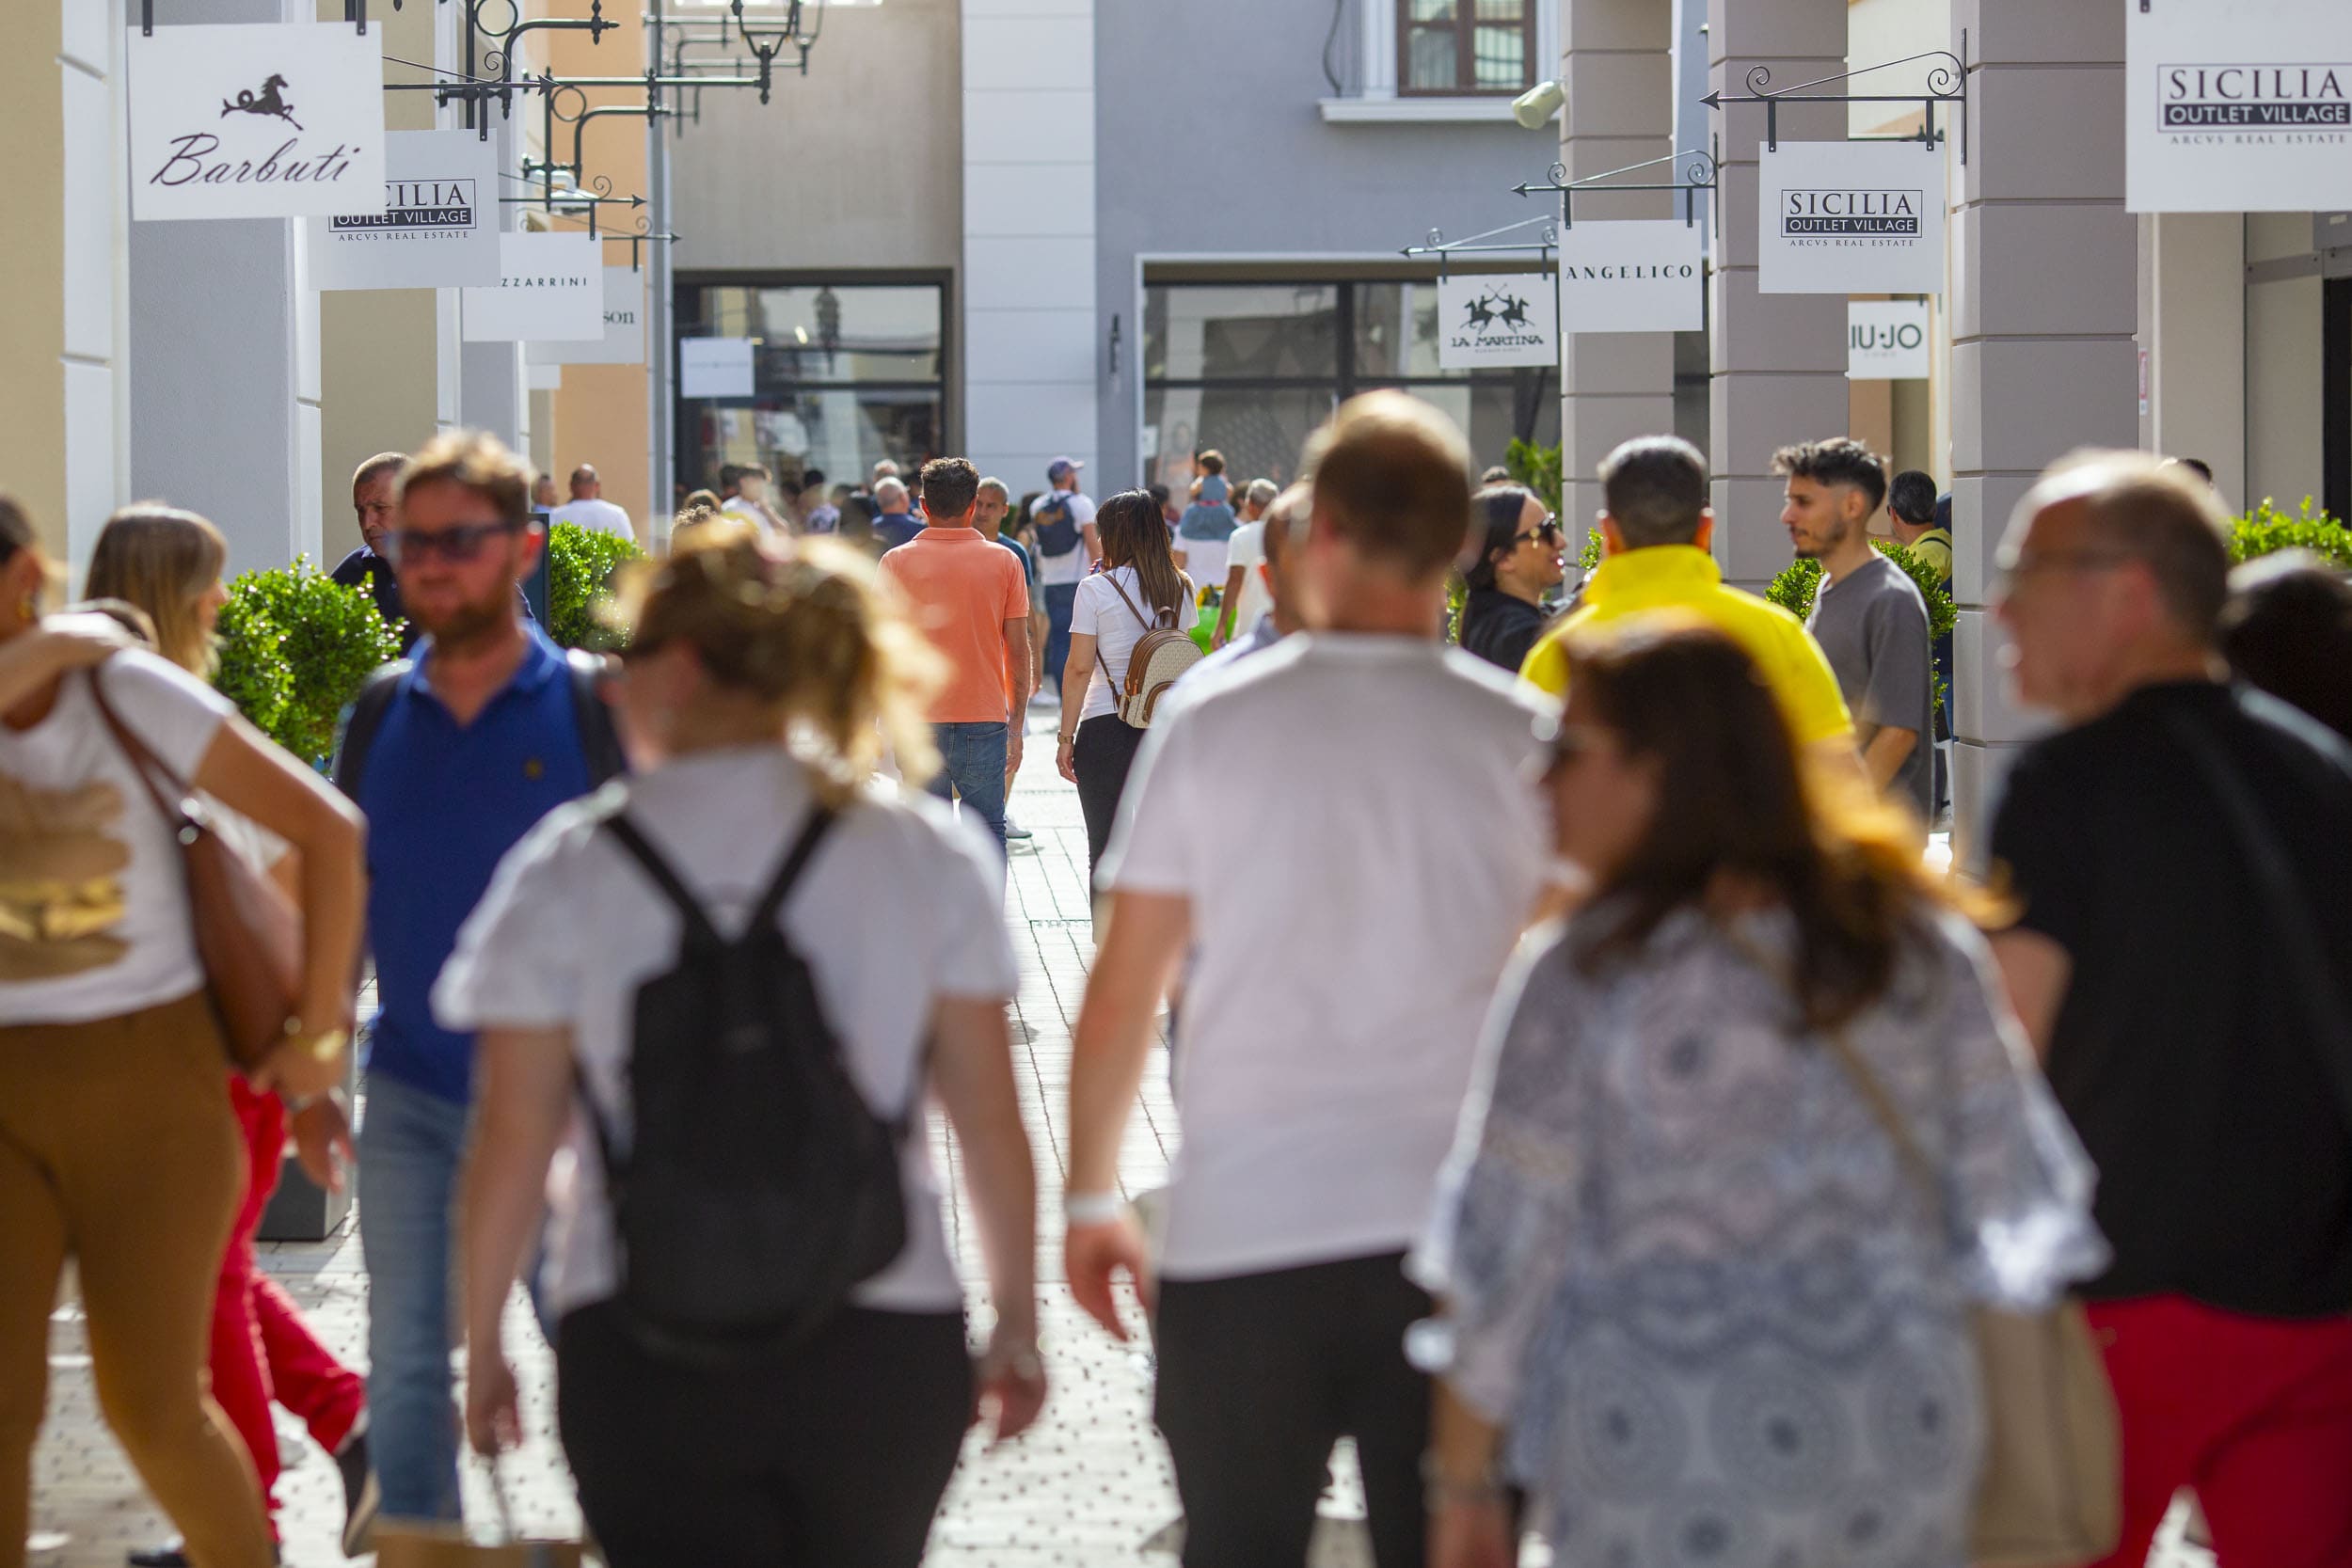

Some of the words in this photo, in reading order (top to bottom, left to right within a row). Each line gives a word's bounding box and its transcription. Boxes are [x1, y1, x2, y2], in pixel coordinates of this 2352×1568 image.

[2169, 69, 2344, 100] SICILIA
[2169, 105, 2253, 123] OUTLET
[2261, 104, 2345, 122] VILLAGE
[2170, 135, 2224, 144] ARCVS
[2235, 135, 2275, 144] REAL
[2287, 134, 2344, 144] ESTATE
[150, 133, 361, 185] Barbuti
[1789, 193, 1915, 214] SICILIA
[338, 212, 399, 225] OUTLET
[405, 210, 468, 223] VILLAGE
[1789, 219, 1849, 231] OUTLET
[1853, 219, 1914, 231] VILLAGE
[339, 233, 378, 242] ARCVS
[1566, 264, 1692, 279] ANGELICO
[1452, 337, 1470, 347] LA
[1474, 335, 1544, 346] MARTINA
